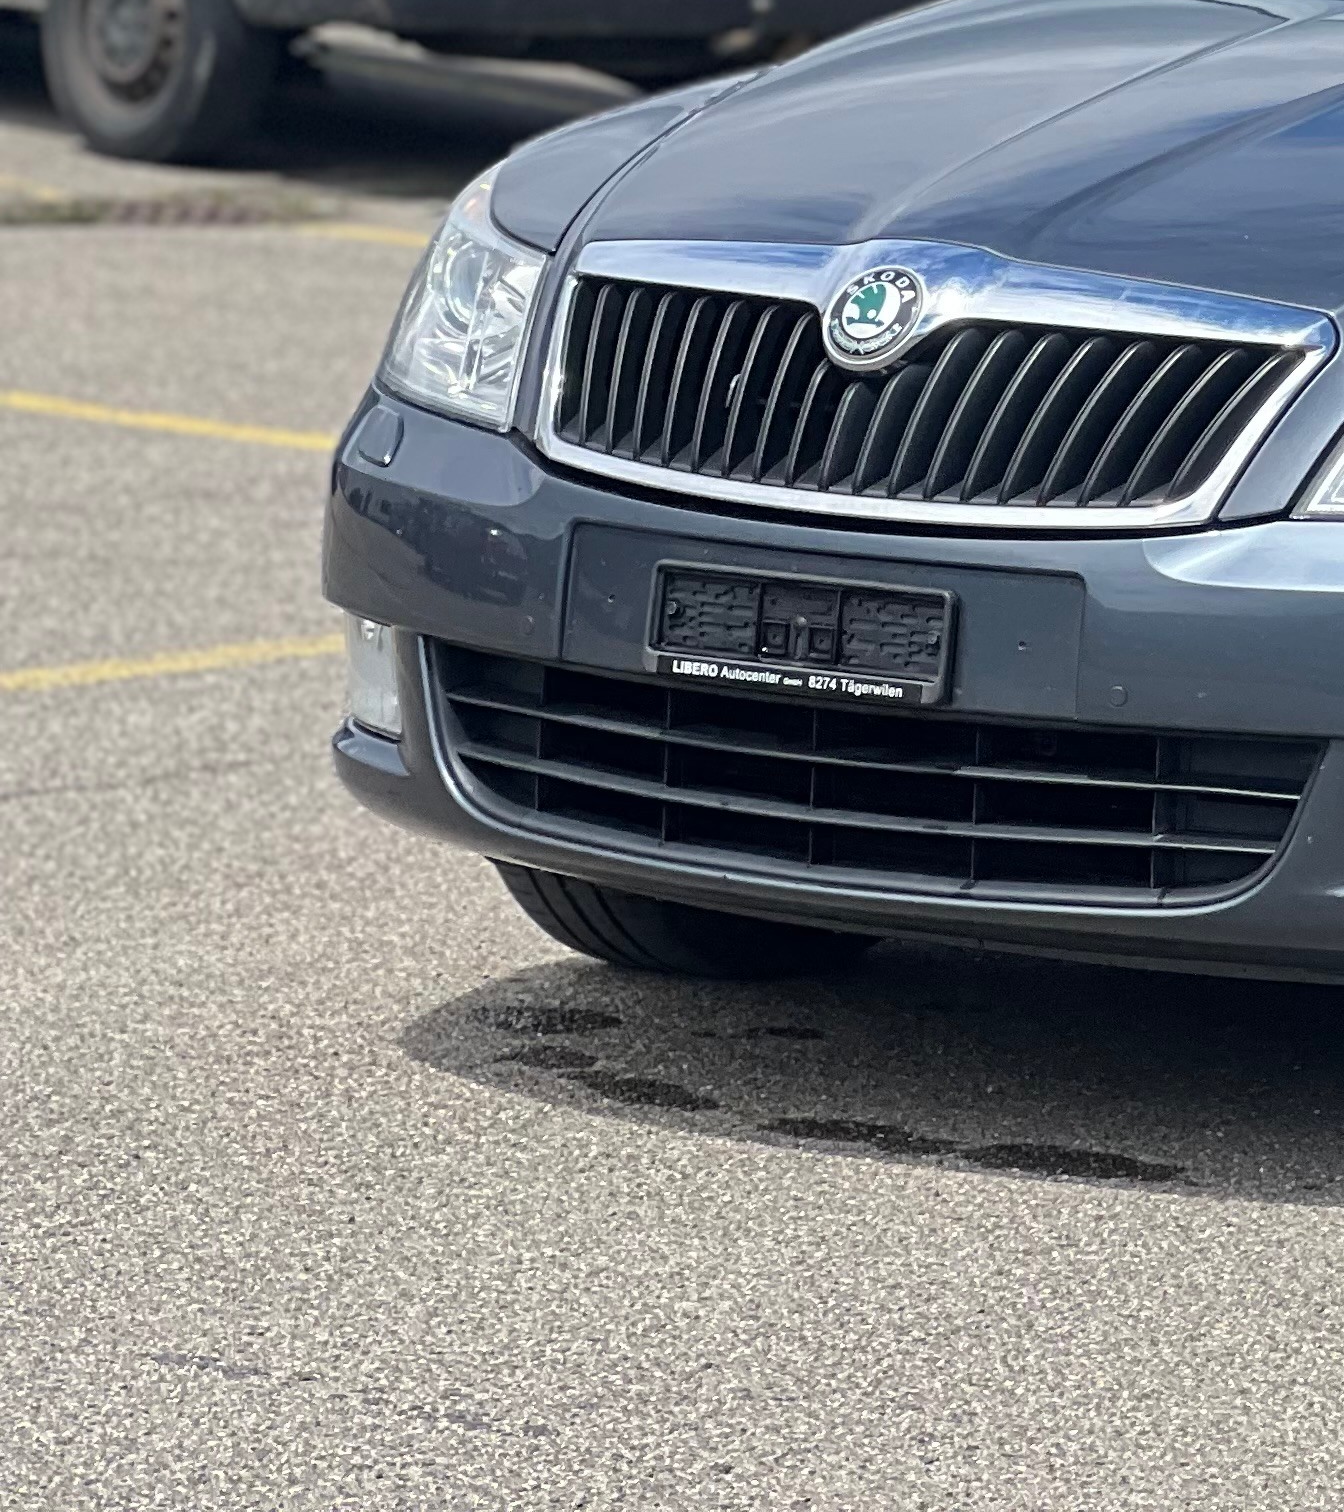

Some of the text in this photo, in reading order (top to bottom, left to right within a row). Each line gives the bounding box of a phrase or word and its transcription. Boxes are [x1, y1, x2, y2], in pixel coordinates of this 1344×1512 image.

[672, 659, 719, 678] LIBERO
[720, 665, 782, 685] Autocenter
[808, 675, 837, 690] 8274
[840, 678, 903, 698] Tägerwilen
